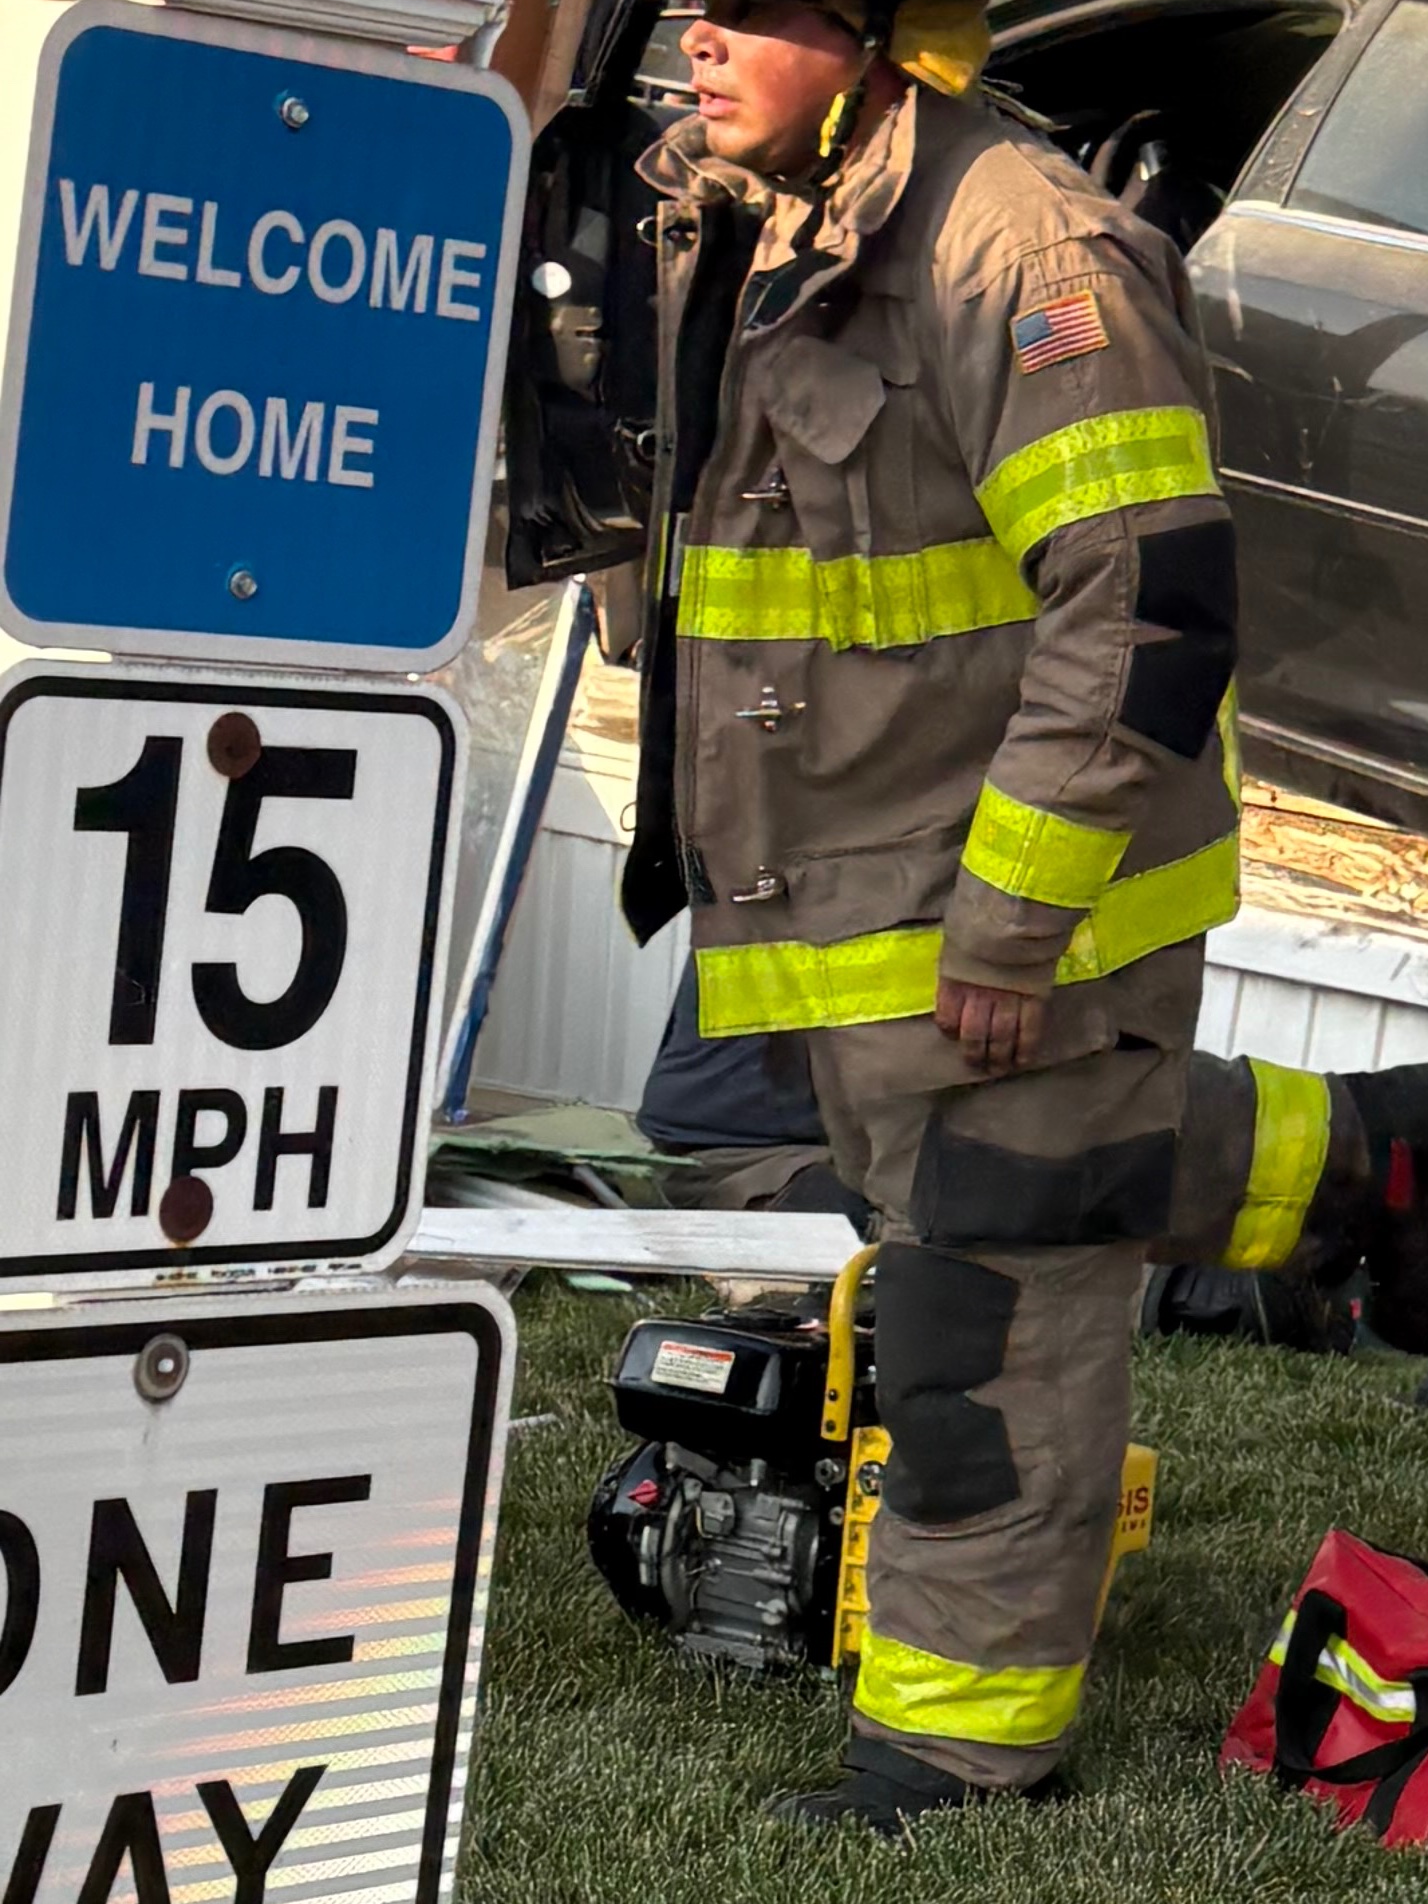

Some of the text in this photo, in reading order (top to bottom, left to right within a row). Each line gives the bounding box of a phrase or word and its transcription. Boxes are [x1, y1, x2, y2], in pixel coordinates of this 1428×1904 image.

[59, 178, 487, 322] WELCOME
[130, 381, 379, 487] HOME
[73, 735, 358, 1051] 15
[56, 1085, 339, 1220] MPH
